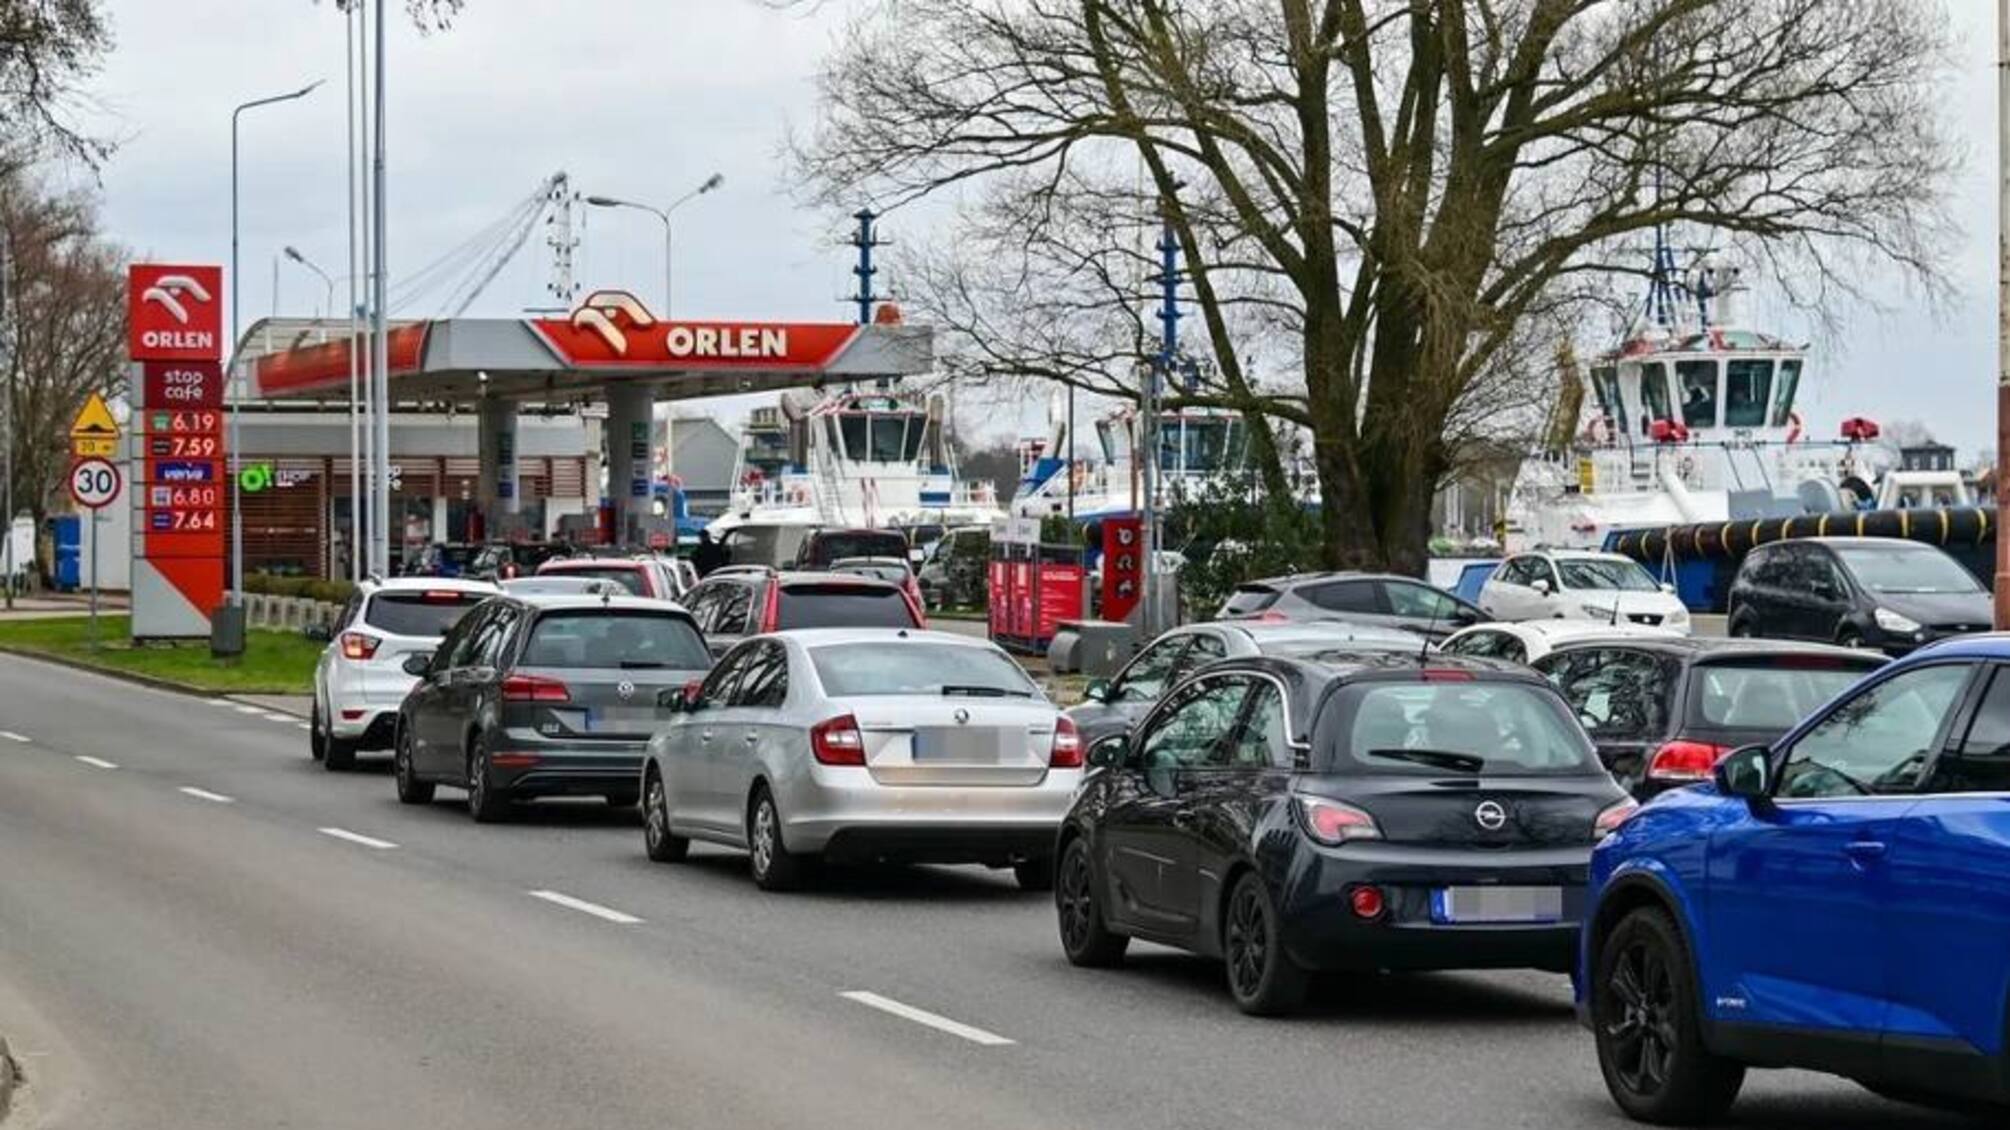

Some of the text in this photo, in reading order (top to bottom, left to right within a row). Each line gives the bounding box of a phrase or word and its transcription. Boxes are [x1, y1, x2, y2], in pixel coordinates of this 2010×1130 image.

[142, 330, 213, 349] ORLEN
[666, 326, 788, 357] ORLEN
[164, 369, 203, 385] stop
[164, 385, 203, 400] cafe
[173, 413, 215, 431] 6.19
[174, 438, 215, 456] 7.59
[77, 468, 113, 494] 30
[173, 487, 215, 505] 6.80
[174, 511, 215, 529] 7.64
